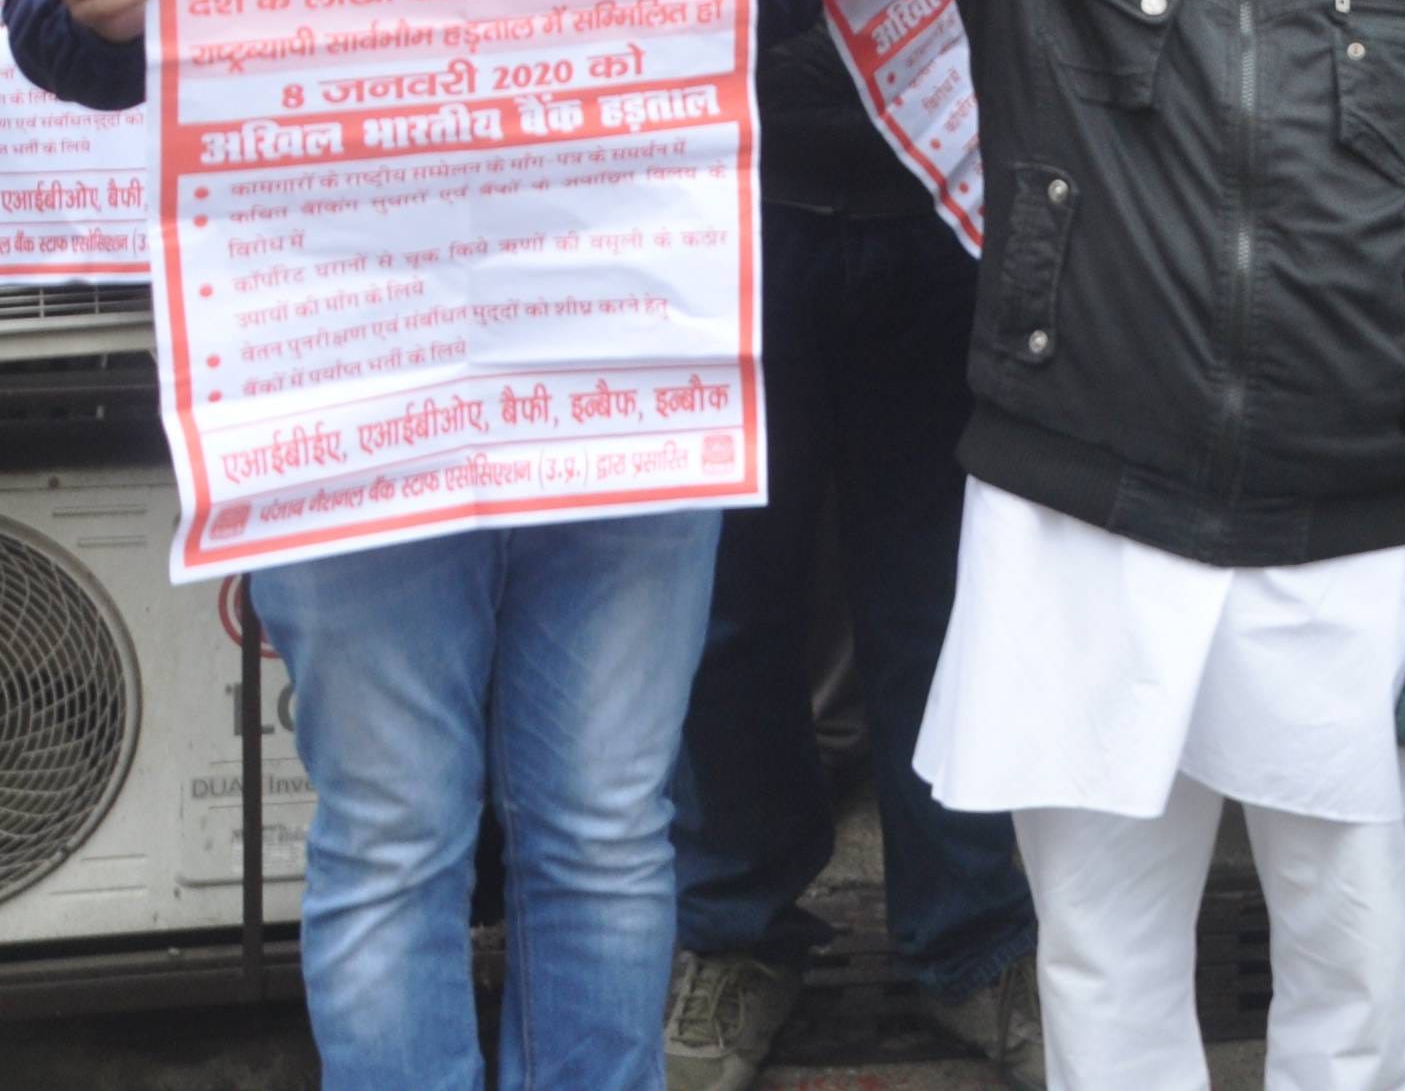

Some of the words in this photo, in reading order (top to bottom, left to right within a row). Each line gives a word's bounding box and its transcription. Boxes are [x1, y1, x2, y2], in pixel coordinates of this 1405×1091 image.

[443, 15, 534, 54] हड़ताल
[543, 5, 567, 35] में
[282, 83, 305, 110] 8
[317, 57, 478, 104] जनवरी
[492, 59, 574, 90] 2020
[587, 41, 645, 78] को
[200, 120, 342, 166] अखिल
[362, 103, 503, 150] भारतीय
[512, 92, 583, 136] बैंक
[598, 84, 720, 132] हड़ताल
[191, 777, 243, 799] DUA
